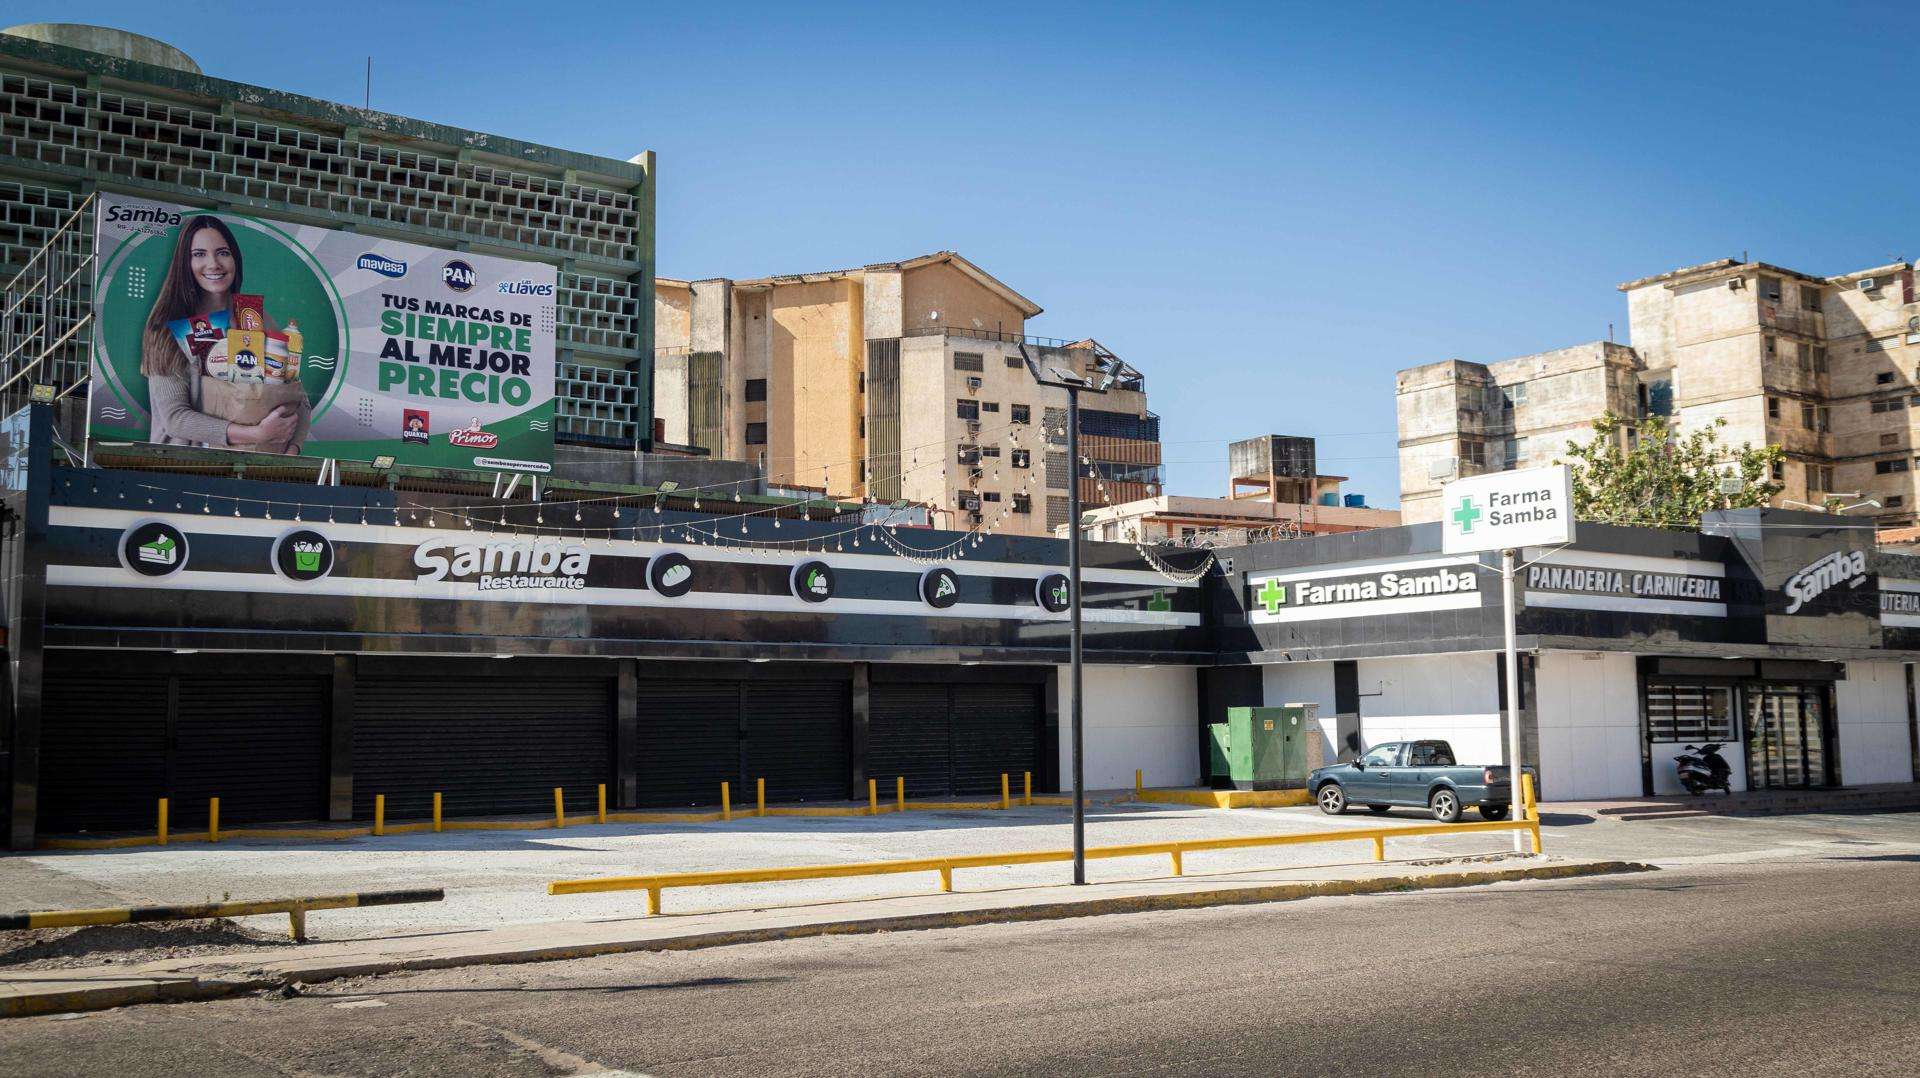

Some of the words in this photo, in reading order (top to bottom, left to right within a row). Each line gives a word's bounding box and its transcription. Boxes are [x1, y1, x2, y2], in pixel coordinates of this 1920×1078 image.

[105, 205, 181, 226] Samba
[360, 257, 404, 274] mavesa
[442, 267, 477, 286] PAN
[508, 282, 553, 297] Llaves
[381, 293, 420, 312] TUS
[425, 300, 505, 323] MARCAS
[510, 312, 532, 327] DE
[380, 310, 532, 353] SIEMPRE
[235, 354, 258, 366] PAN
[380, 337, 420, 363] AL
[429, 343, 531, 377] MEJOR
[378, 361, 532, 407] PRECIO
[403, 430, 429, 440] QUAKER
[450, 429, 498, 443] Primor
[1489, 488, 1551, 508] Farma
[1489, 506, 1557, 526] Samba
[413, 537, 592, 586] Samba
[479, 574, 585, 591] Restaurante
[1294, 580, 1379, 606] Farma
[1380, 568, 1478, 599] Samba
[1529, 566, 1624, 593] PANADERIA
[1631, 573, 1720, 600] CARNICERIA
[1784, 550, 1866, 614] Samba
